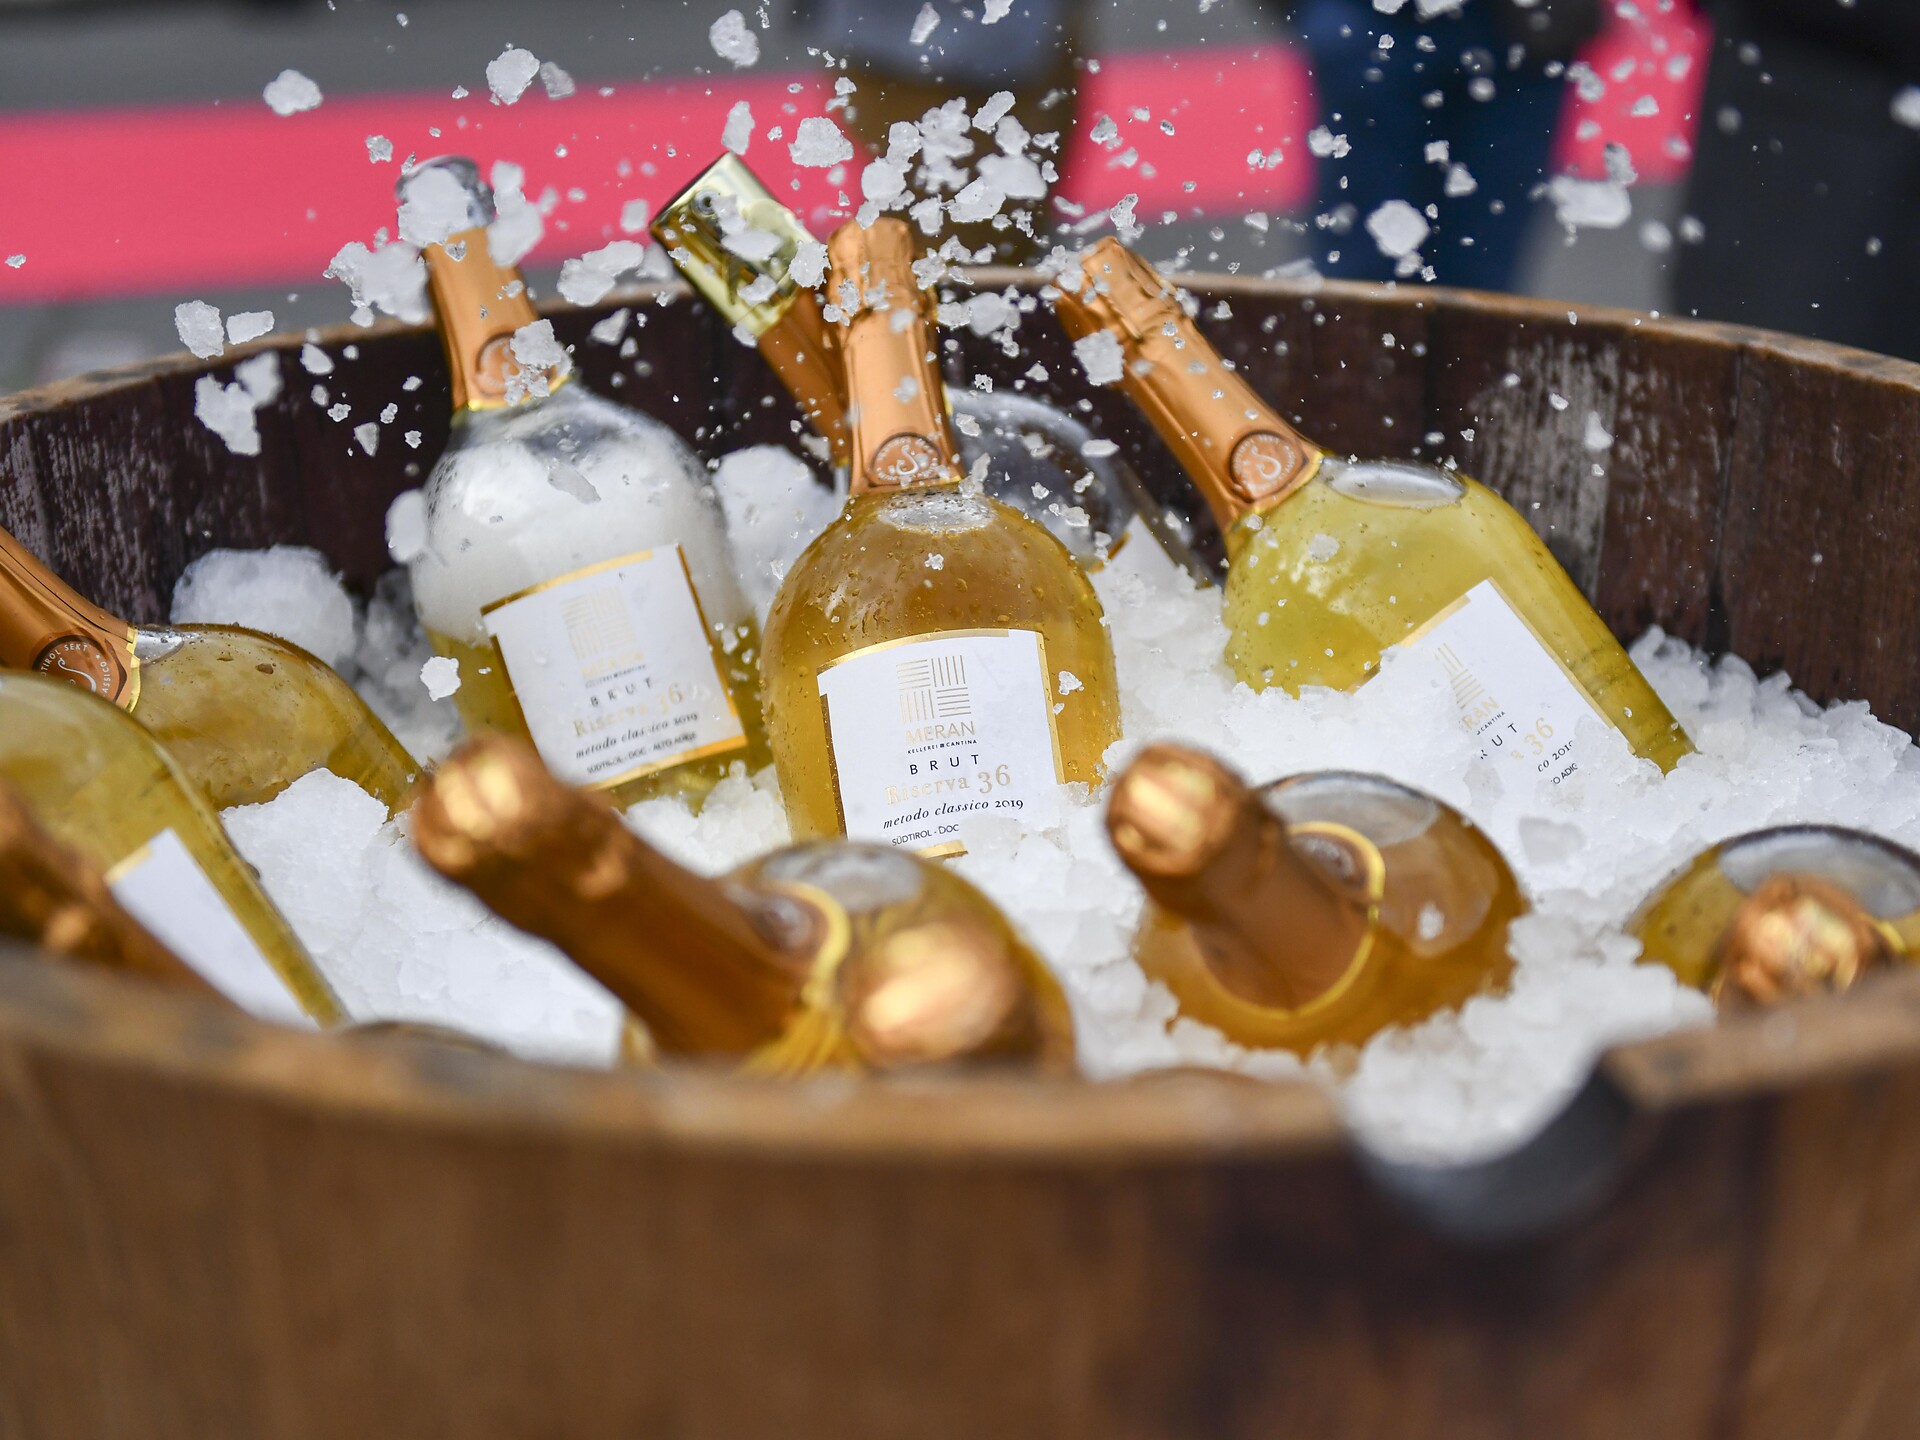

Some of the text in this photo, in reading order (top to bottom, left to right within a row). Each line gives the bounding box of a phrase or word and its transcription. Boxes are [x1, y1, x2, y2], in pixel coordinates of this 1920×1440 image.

[63, 642, 89, 652] SEKT
[99, 660, 112, 694] ASSICO
[590, 676, 652, 707] BRUT
[905, 720, 976, 745] MERAN
[1480, 711, 1506, 732] CANTINA
[576, 736, 617, 760] metodo
[907, 739, 978, 755] KELLEREI CANTINA
[1524, 717, 1554, 756] 36
[909, 754, 980, 775] BRUT
[885, 764, 1012, 806] Riserva 36
[883, 799, 1024, 830] metodo classico 2019
[891, 829, 933, 847] SÜDTIROL
[938, 823, 960, 835] DOC
